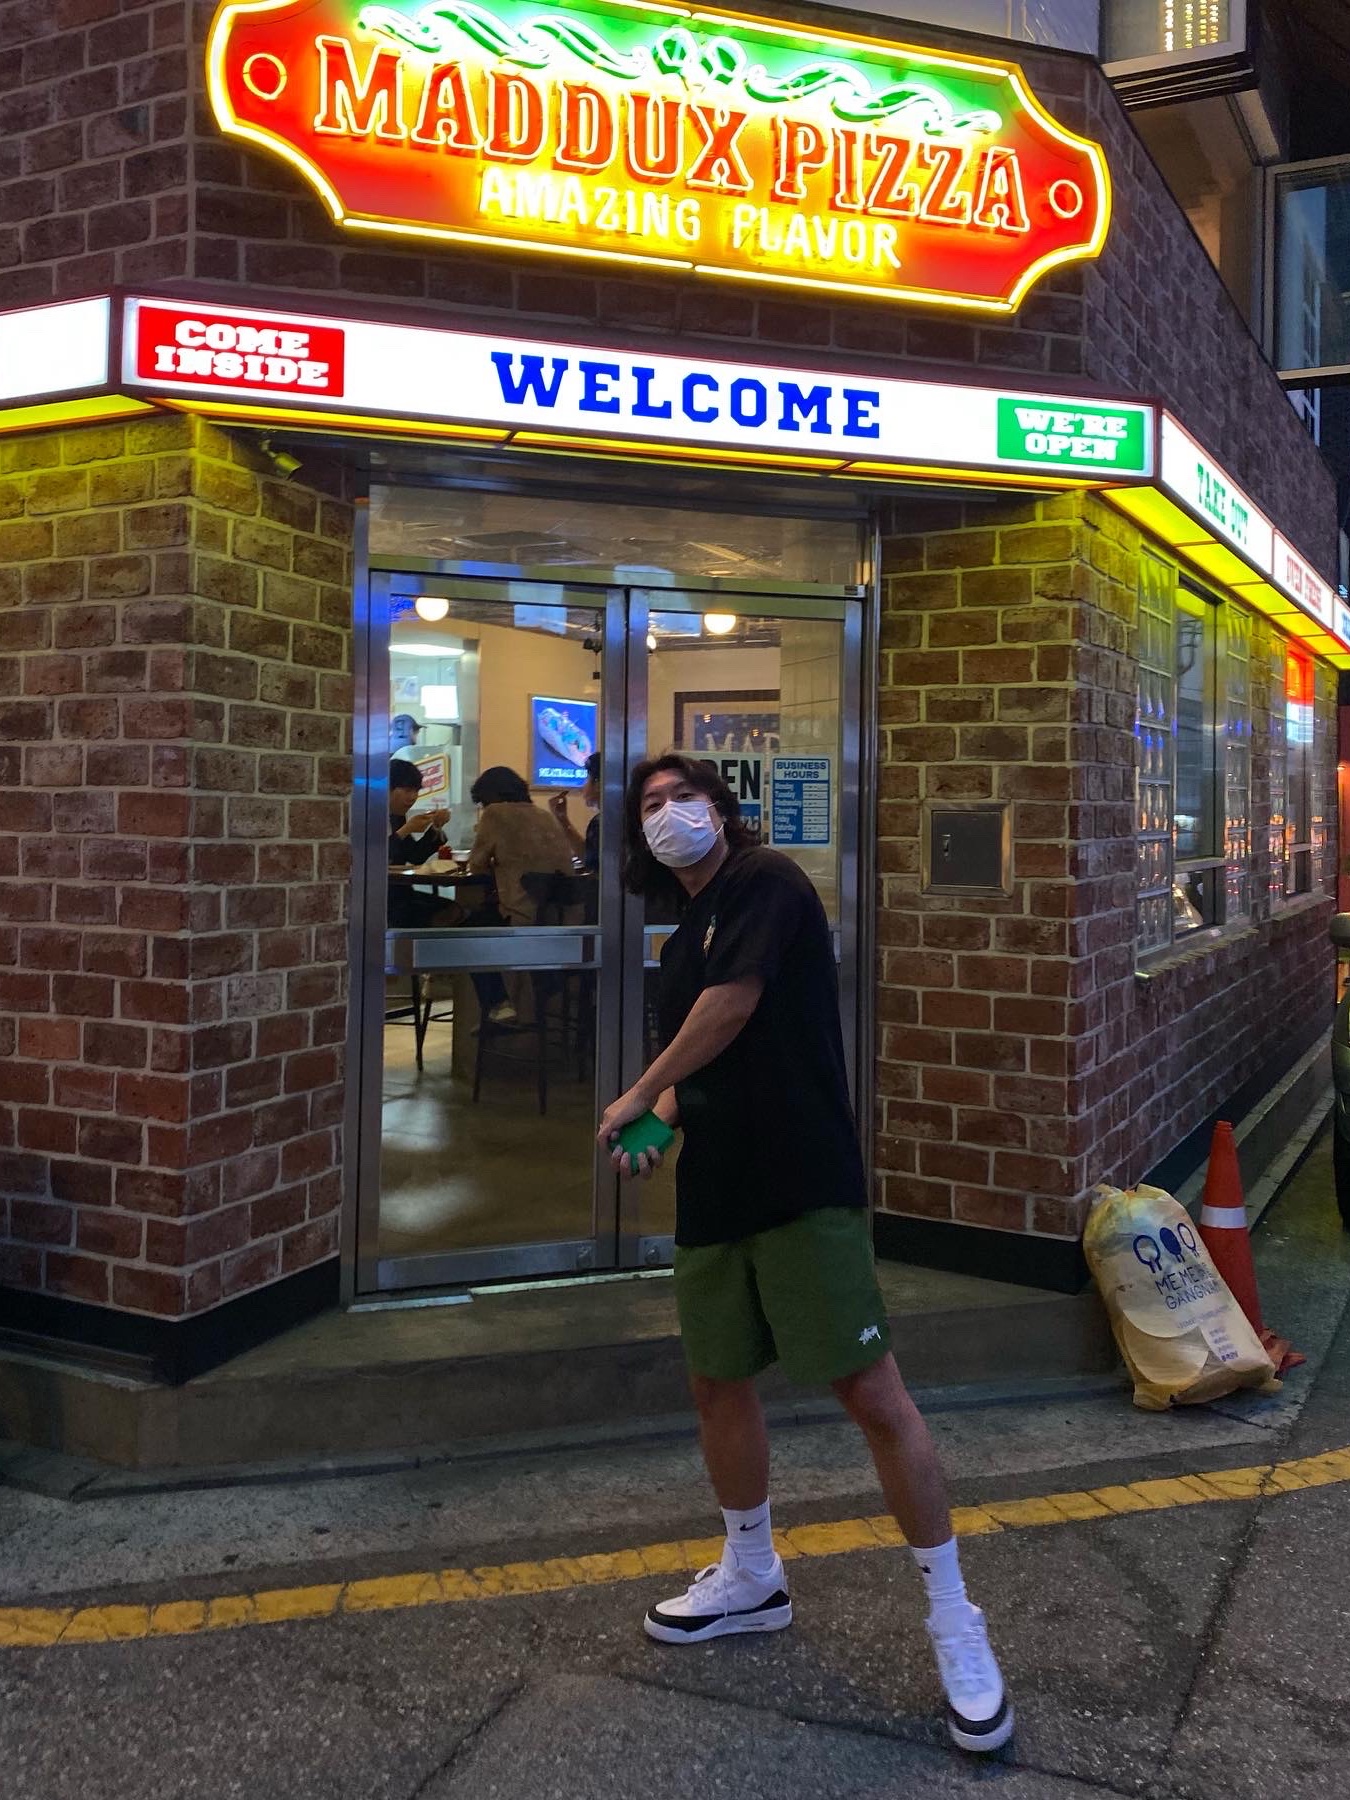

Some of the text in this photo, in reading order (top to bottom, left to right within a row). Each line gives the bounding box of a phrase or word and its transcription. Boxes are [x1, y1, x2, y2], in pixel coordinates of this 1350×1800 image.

[313, 34, 1031, 235] MADDUX PIZZA
[479, 165, 702, 242] AMAZING
[174, 319, 310, 359] COME
[154, 345, 329, 388] INSIDE
[490, 351, 880, 439] WELCOME
[1013, 407, 1129, 439] WE'RE
[1024, 432, 1119, 461] OPEN
[776, 761, 827, 770] BUSINESS
[783, 771, 820, 779] HOURS
